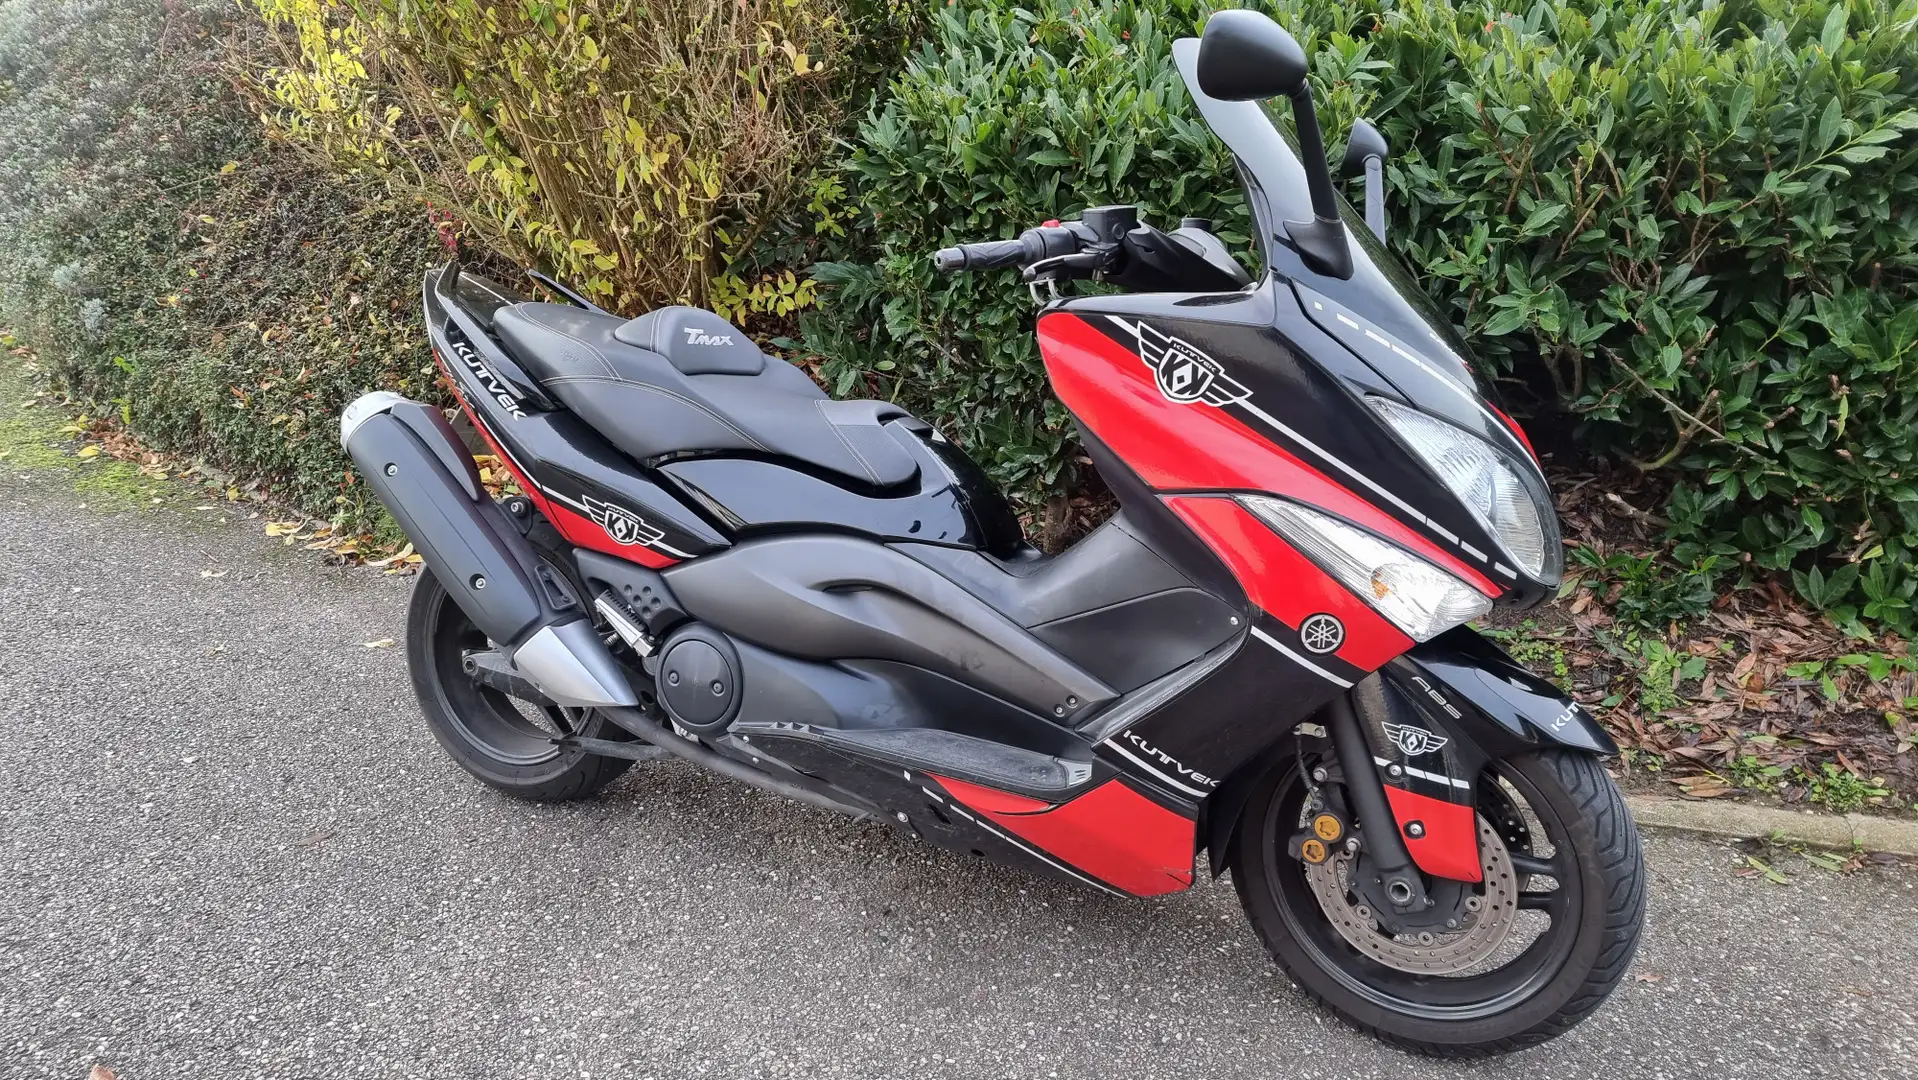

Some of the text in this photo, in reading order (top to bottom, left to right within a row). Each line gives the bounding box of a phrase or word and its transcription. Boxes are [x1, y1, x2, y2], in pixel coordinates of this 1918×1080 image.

[1173, 343, 1217, 373] KUTVEK
[452, 341, 528, 422] KUTVEK
[1411, 676, 1463, 719] ABS
[1550, 701, 1581, 732] KUT
[1123, 729, 1221, 788] KUTVEK
